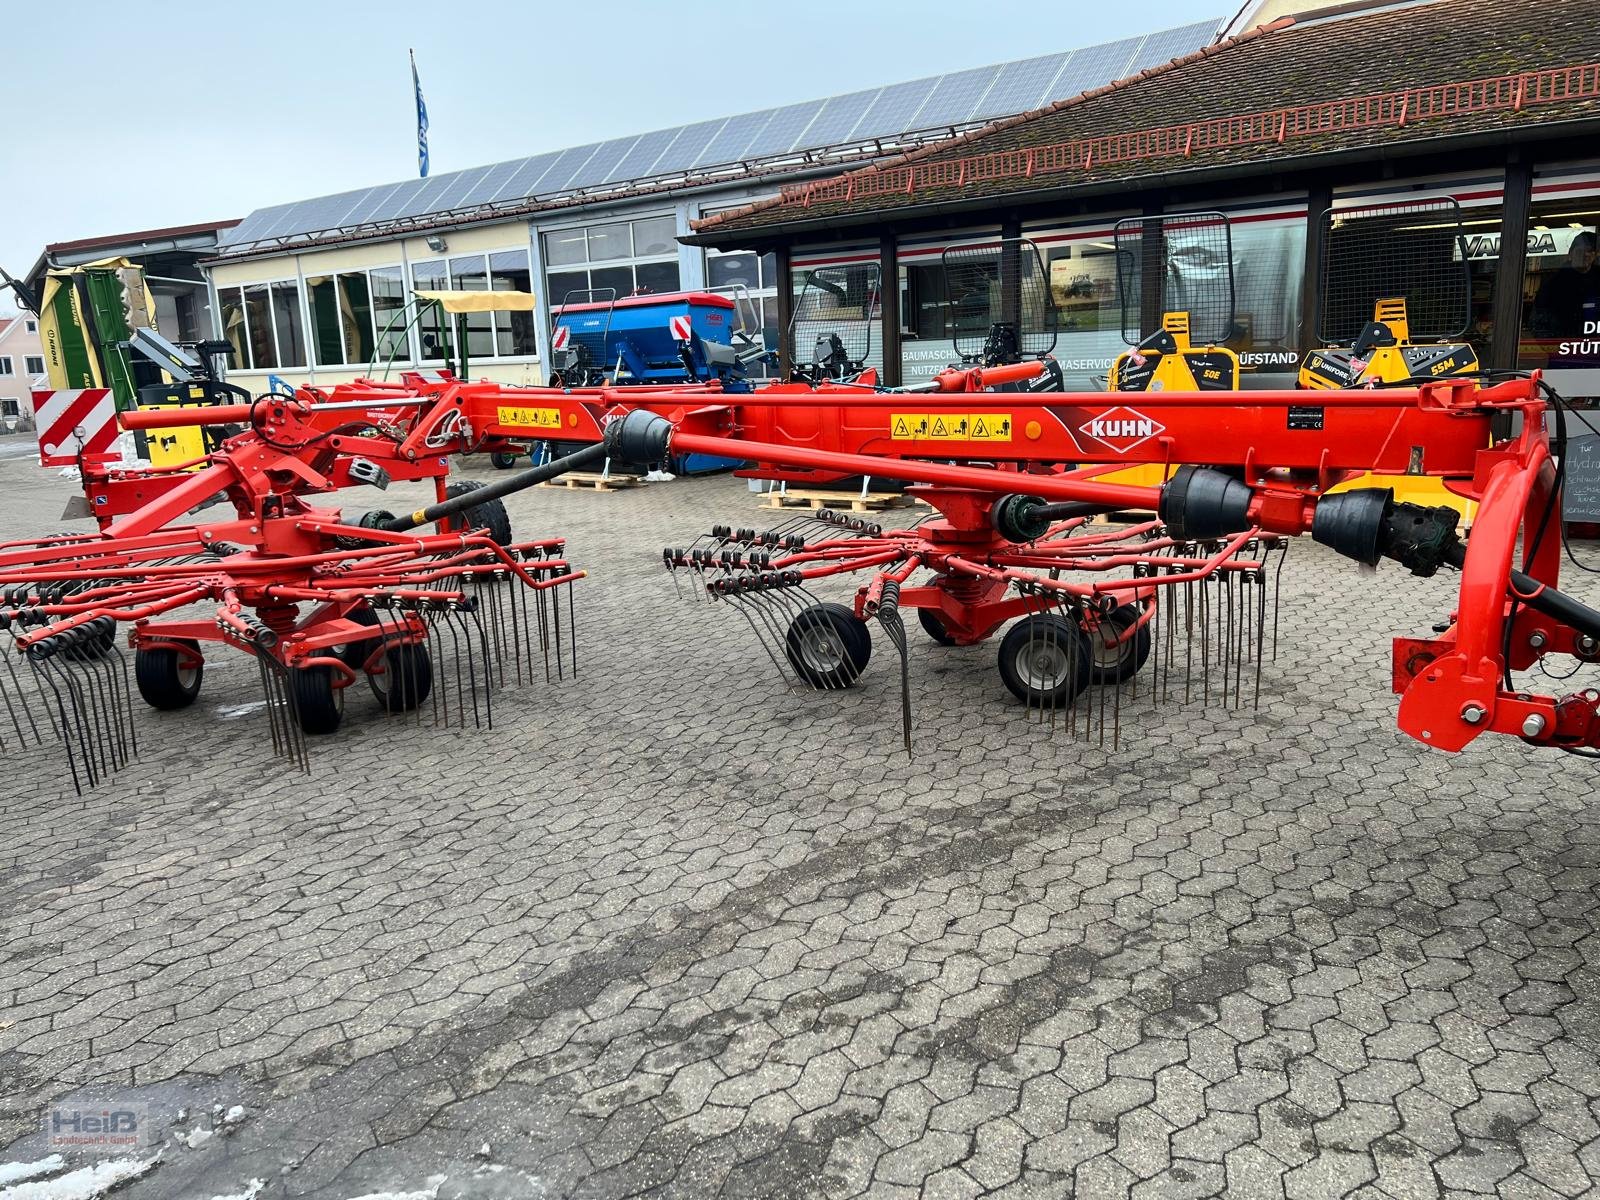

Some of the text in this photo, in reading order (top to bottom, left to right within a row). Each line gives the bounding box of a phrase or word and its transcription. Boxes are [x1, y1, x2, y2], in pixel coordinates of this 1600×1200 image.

[1458, 233, 1556, 258] VARA
[48, 340, 59, 367] KRONE
[911, 365, 948, 376] NUTZFA
[1203, 369, 1221, 380] 50E
[1430, 358, 1455, 376] 55M
[83, 373, 91, 388] EAS
[1092, 420, 1152, 437] KUHN
